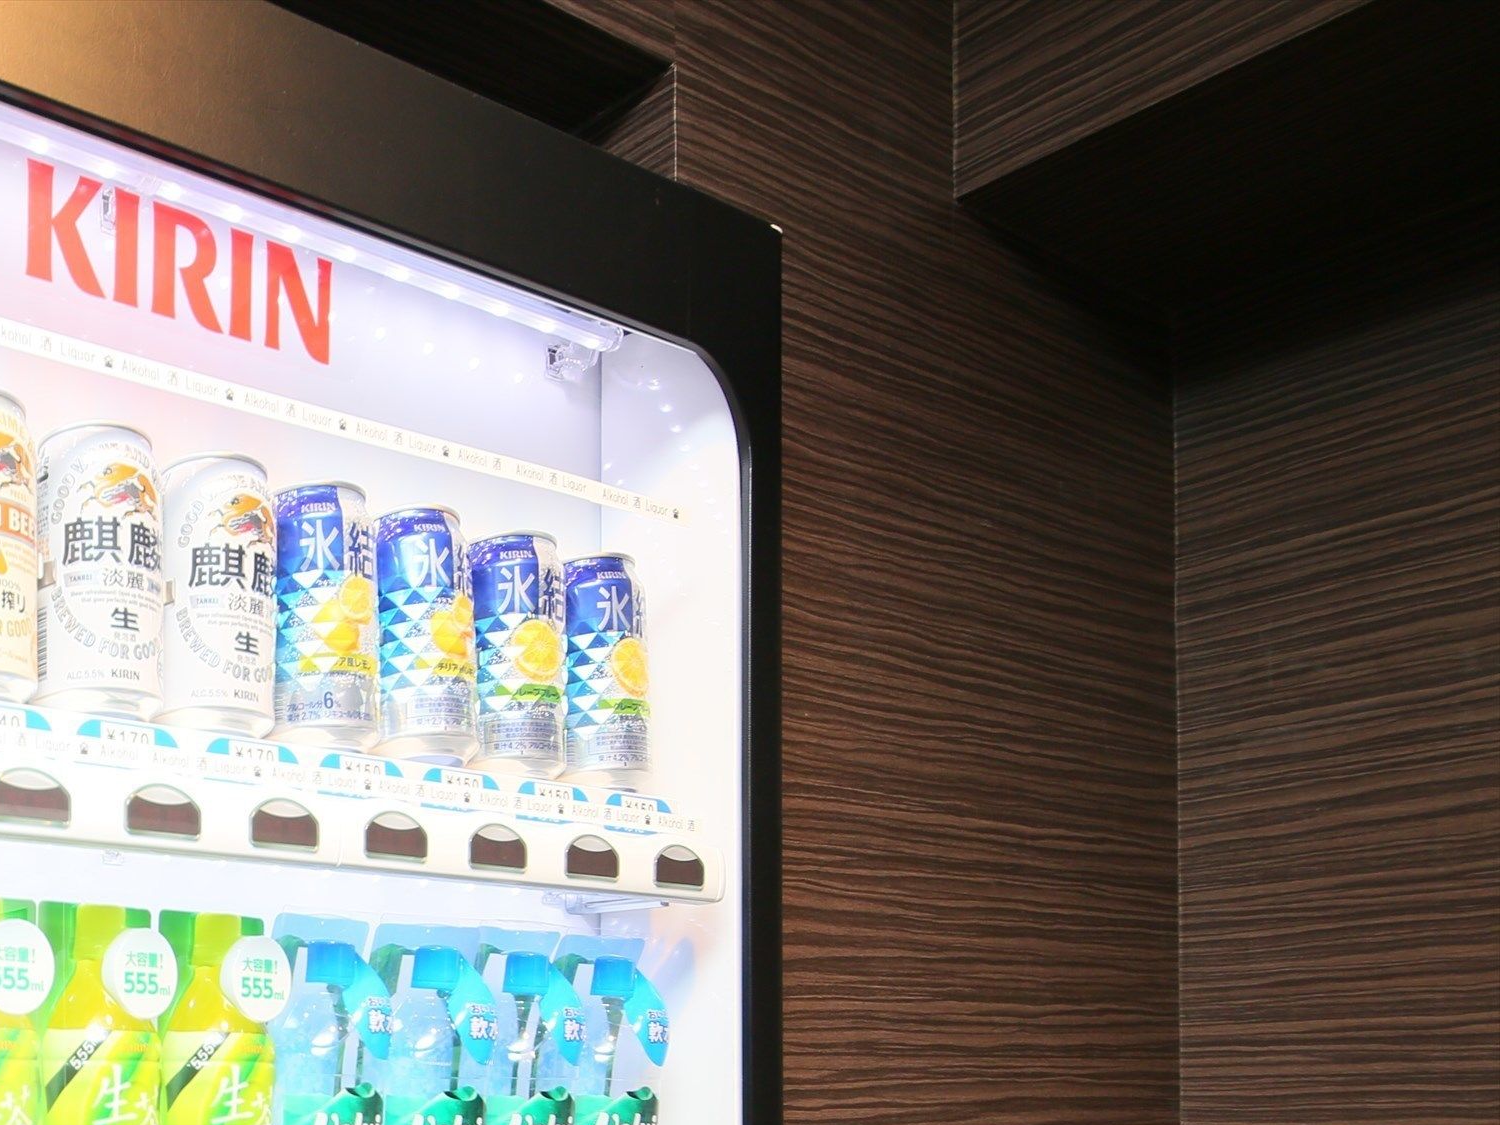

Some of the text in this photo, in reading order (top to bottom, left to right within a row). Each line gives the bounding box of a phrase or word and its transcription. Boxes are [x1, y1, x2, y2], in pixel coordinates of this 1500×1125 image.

[25, 157, 332, 366] KIRIN
[244, 392, 280, 415] Alkohol
[302, 408, 332, 429] Liquor
[355, 421, 388, 445] Alkohol
[409, 435, 437, 456] Liquor
[458, 449, 487, 468] Alkohol
[515, 464, 545, 484] Alkohol
[562, 475, 587, 494] Liquor
[602, 488, 629, 507] Alkohol
[645, 499, 669, 518] Liquor
[301, 502, 336, 513] KIRIN
[414, 524, 446, 532] KIRIN
[499, 550, 533, 560] KIRIN
[102, 567, 145, 592] 淡麗
[596, 571, 626, 579] KIRIN
[51, 585, 129, 660] BREWED FOR
[109, 606, 140, 633] 生
[175, 606, 251, 683] BREWED FOR
[233, 630, 260, 656] 生
[110, 670, 140, 681] KIRIN
[233, 689, 260, 703] KIRIN
[106, 727, 148, 746] ¥170
[122, 971, 171, 997] 555ml
[240, 976, 285, 1001] 555ml
